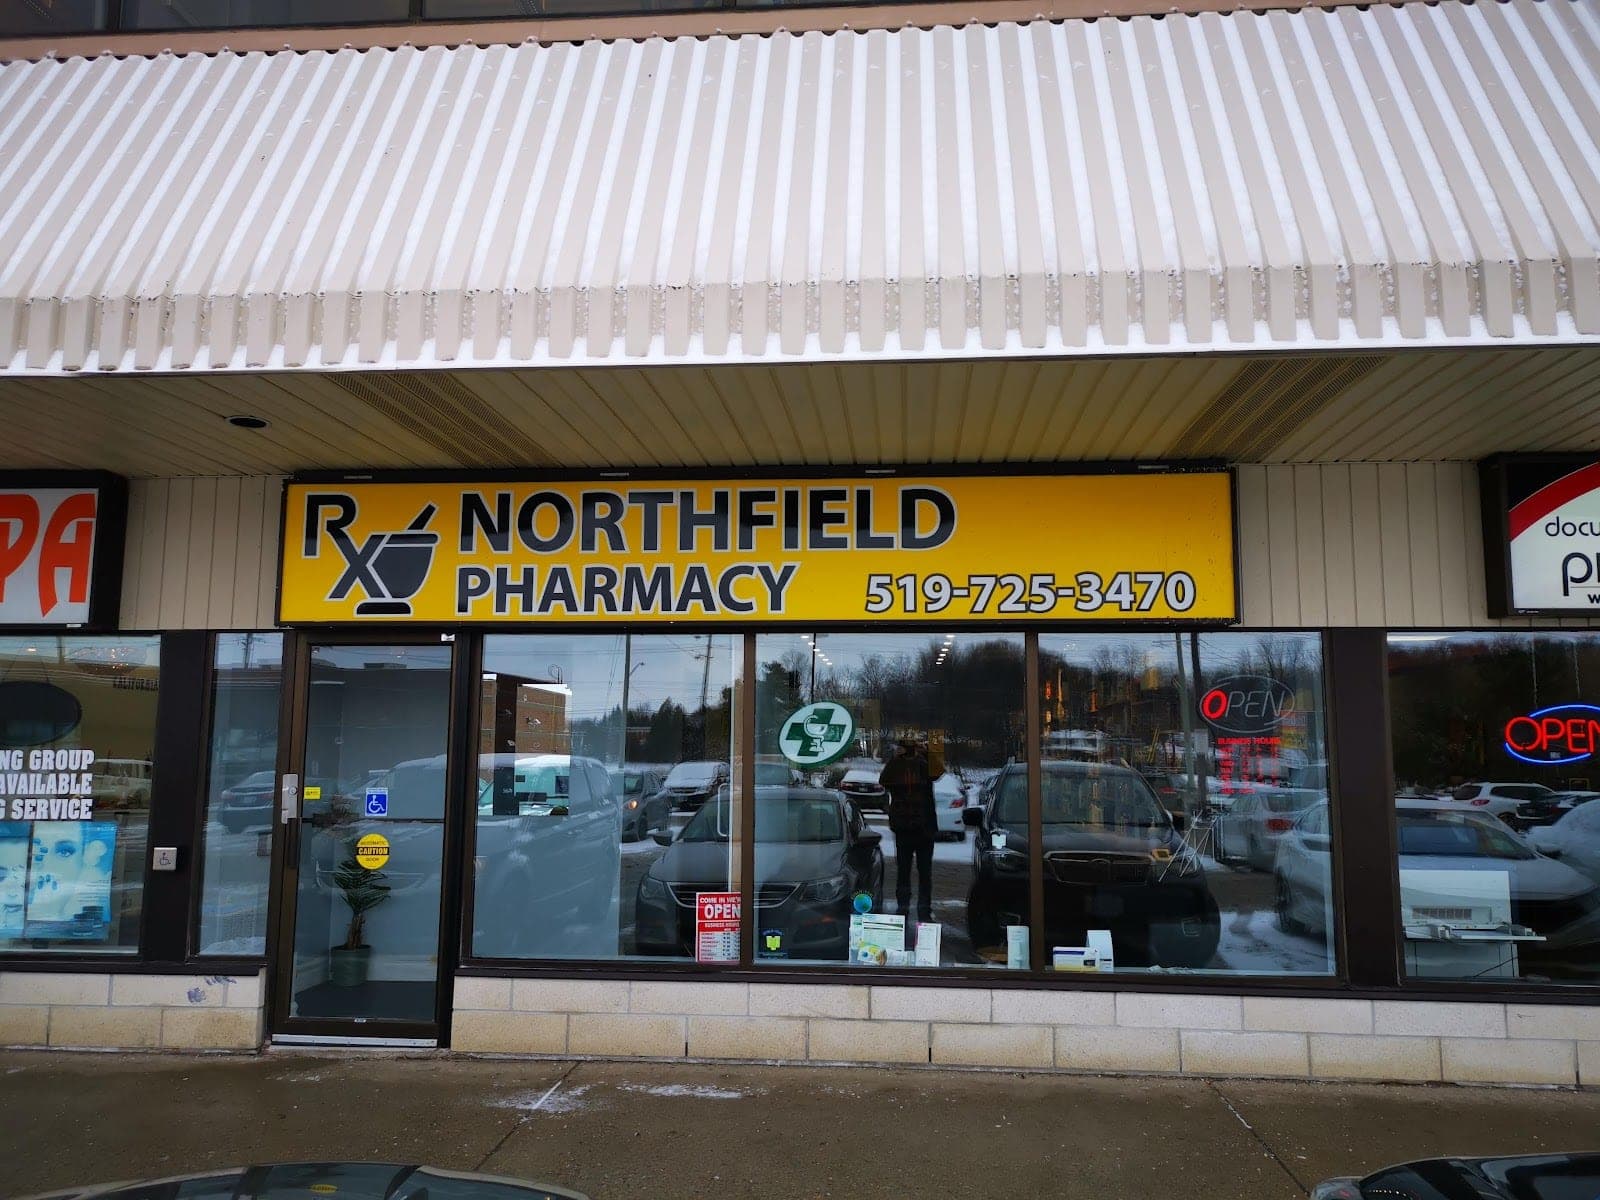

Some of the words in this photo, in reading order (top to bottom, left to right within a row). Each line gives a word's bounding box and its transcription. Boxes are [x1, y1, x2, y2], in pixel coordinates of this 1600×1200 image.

[460, 485, 956, 553] NORTHFIELD
[456, 561, 801, 615] PHARMACY
[865, 571, 1196, 613] 519-725-3470
[1562, 552, 1600, 597] p
[1202, 689, 1285, 719] OPEN
[29, 750, 95, 771] GROUP
[11, 799, 93, 820] SERVICE
[704, 904, 740, 919] OPEN
